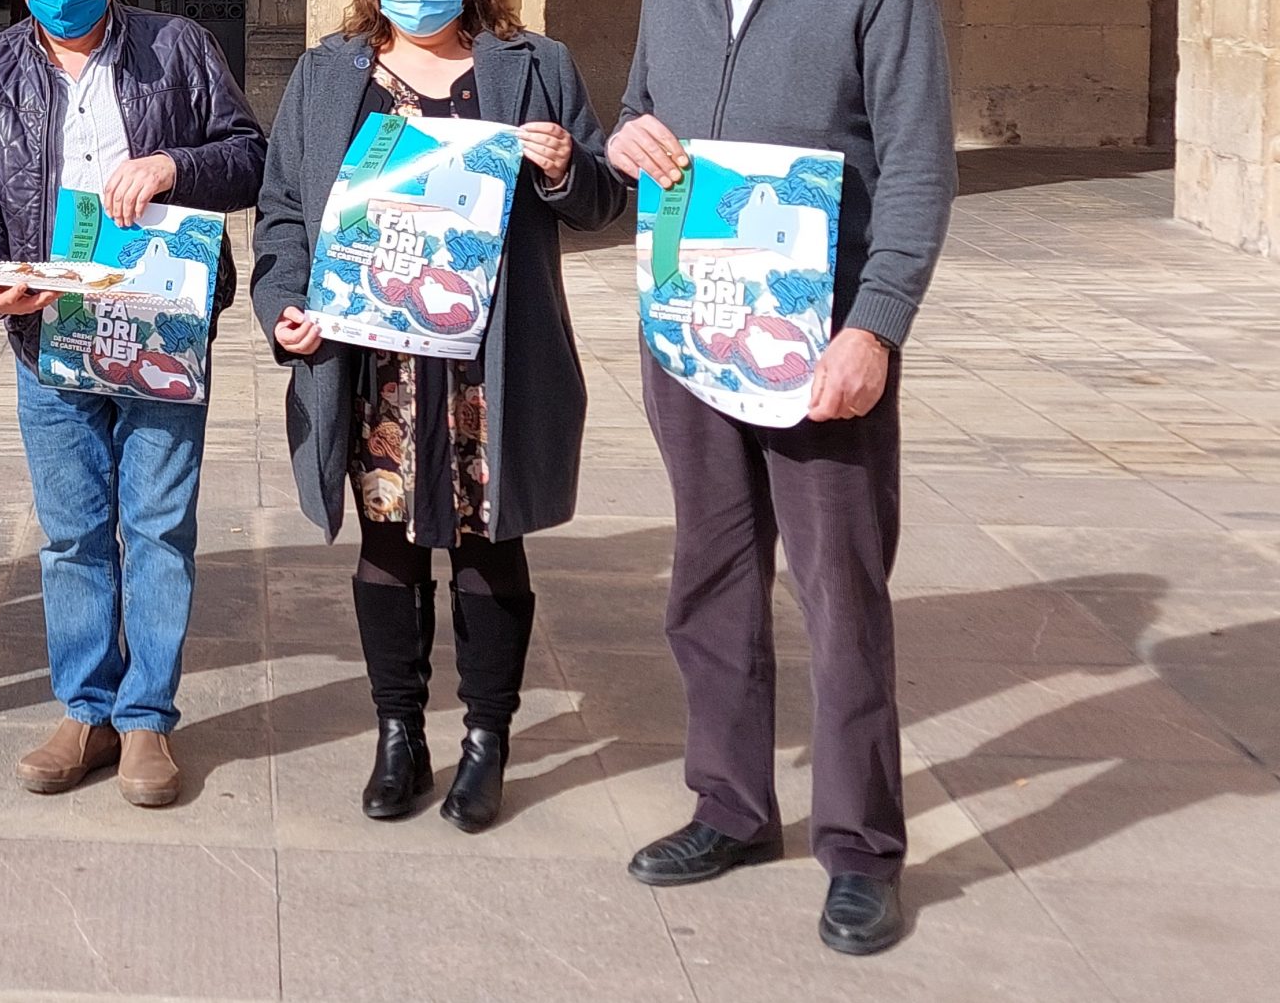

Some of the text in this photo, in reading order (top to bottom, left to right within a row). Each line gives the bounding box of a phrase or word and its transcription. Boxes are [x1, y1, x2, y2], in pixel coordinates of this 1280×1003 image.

[384, 208, 417, 234] FA
[663, 206, 680, 215] 2022
[71, 250, 87, 259] 2022
[379, 228, 425, 256] DRI
[375, 247, 429, 279] NET
[699, 256, 734, 281] FA
[696, 280, 745, 305] DRI
[98, 298, 129, 320] FA
[694, 302, 752, 329] NET
[62, 336, 93, 346] FORNERS
[72, 332, 93, 341] GREMI
[97, 317, 138, 342] DRI
[95, 336, 143, 361] NET
